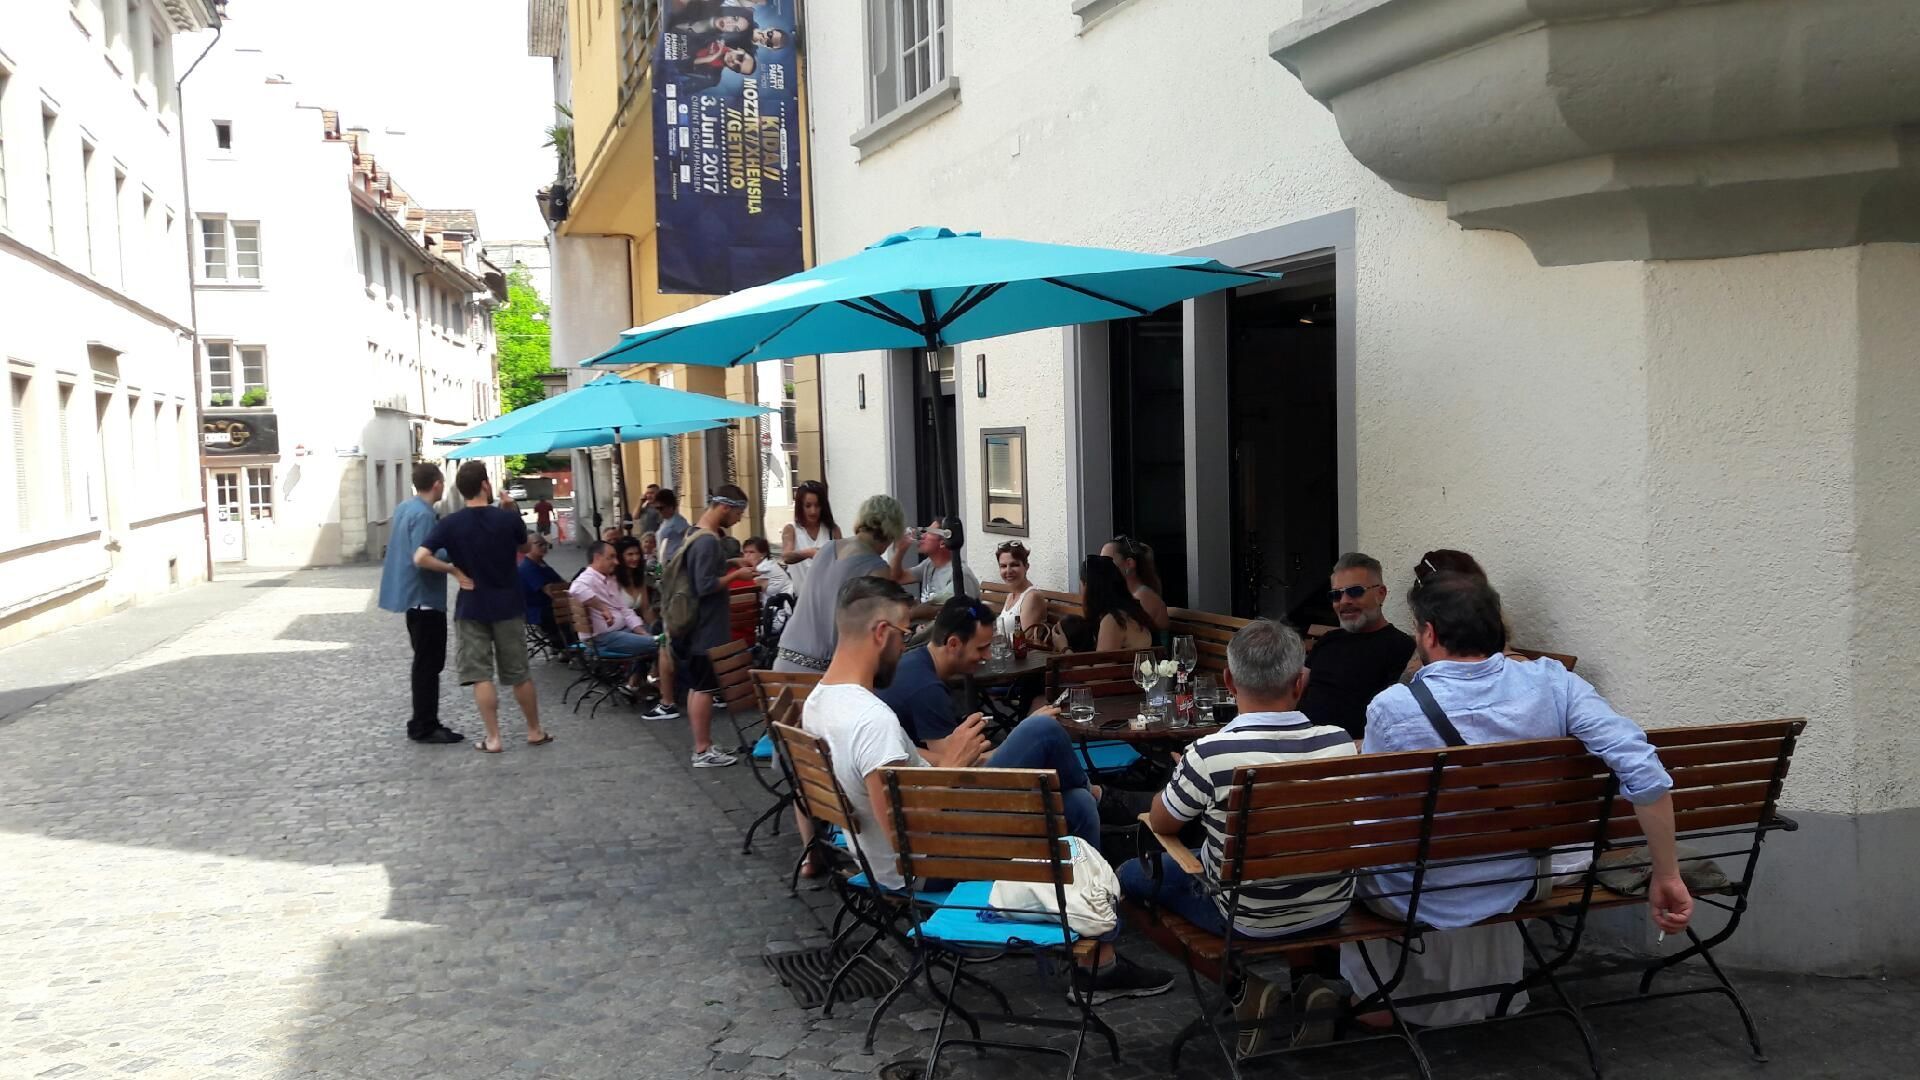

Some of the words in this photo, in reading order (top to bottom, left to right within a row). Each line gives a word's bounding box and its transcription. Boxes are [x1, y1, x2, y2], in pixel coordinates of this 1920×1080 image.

[769, 64, 777, 89] PARTY
[701, 96, 717, 111] 3.
[701, 113, 718, 148] Juni
[702, 153, 720, 193] 2017
